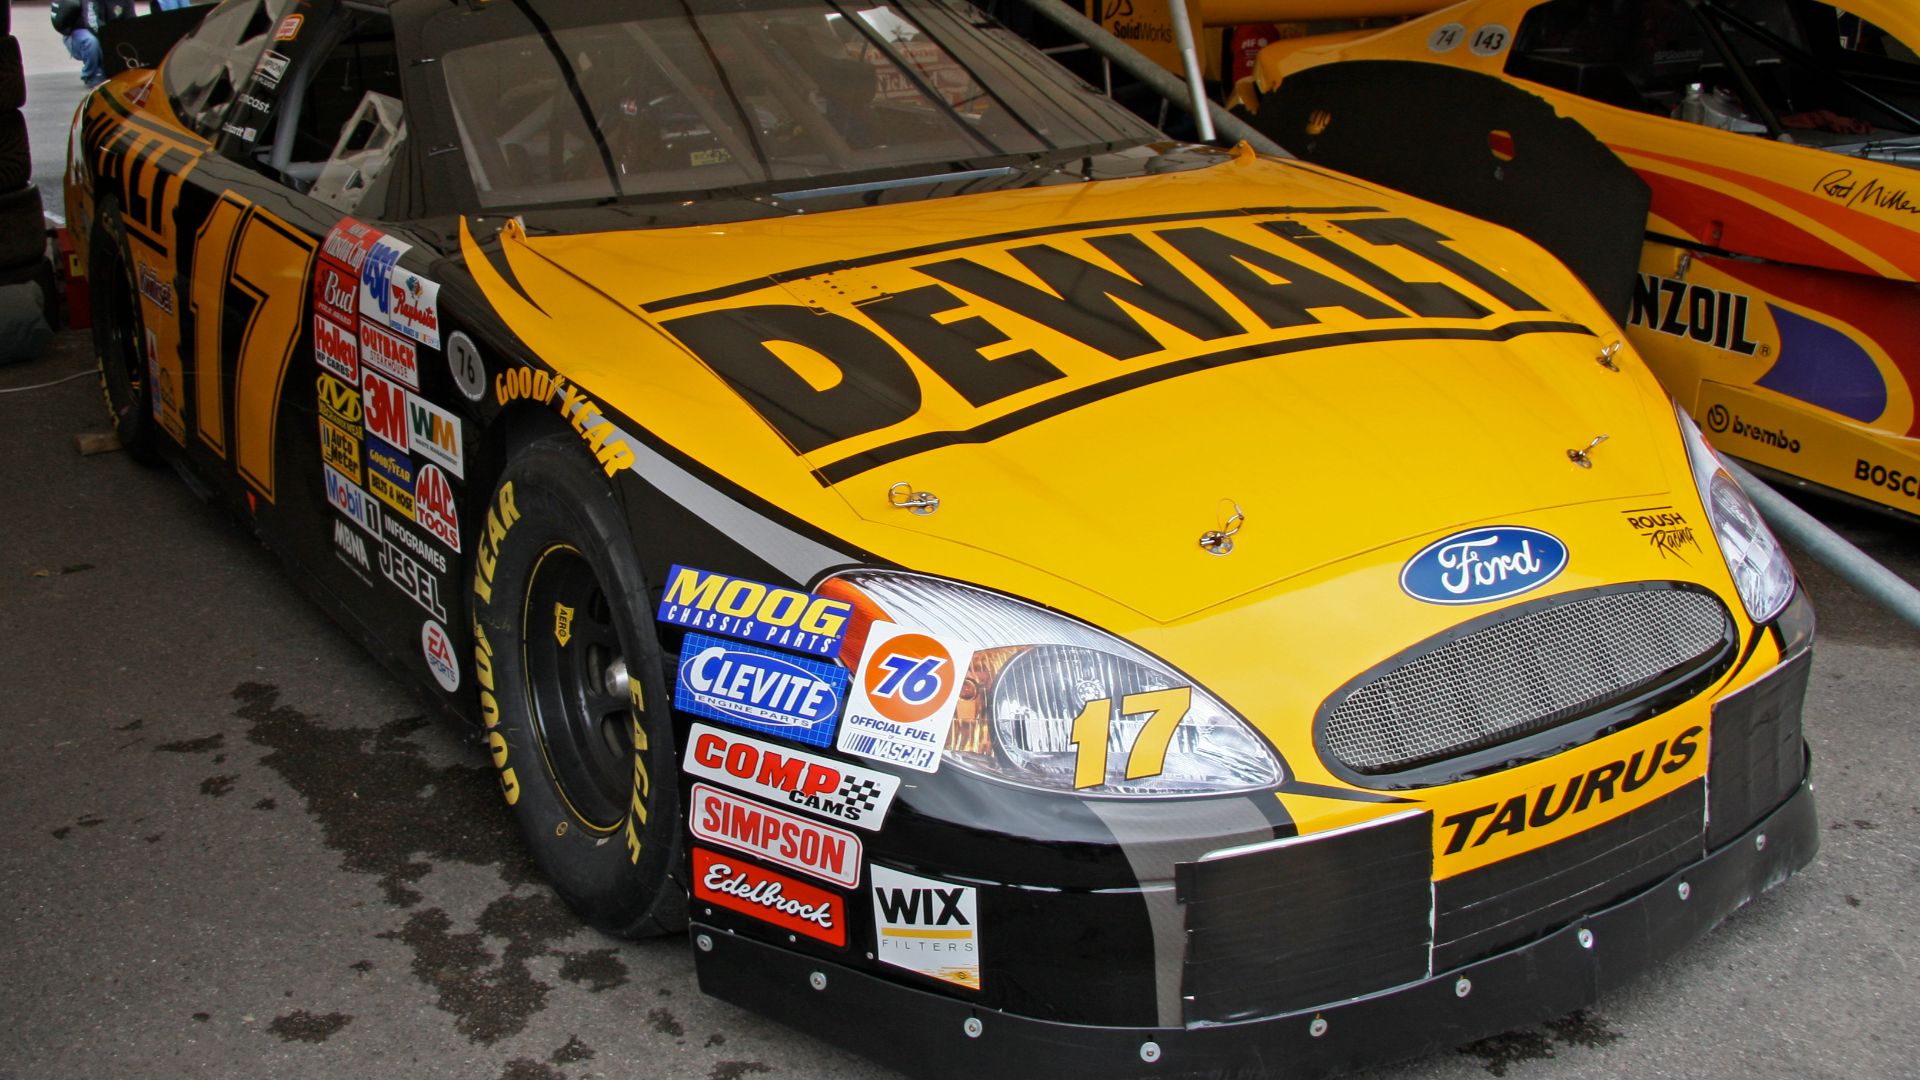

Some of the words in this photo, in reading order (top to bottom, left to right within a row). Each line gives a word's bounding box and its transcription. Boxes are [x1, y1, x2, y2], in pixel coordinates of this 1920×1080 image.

[1113, 21, 1173, 43] SolidWorks
[1436, 30, 1457, 46] 74
[1473, 31, 1505, 50] 143
[1813, 169, 1857, 199] Rod
[324, 271, 357, 315] Bud
[1628, 272, 1760, 357] NZOIL
[189, 189, 320, 505] 17
[316, 319, 358, 381] Holley
[361, 325, 416, 372] OUTBACK
[659, 217, 1551, 457] DEWALT
[326, 357, 351, 379] CARBS
[370, 351, 408, 379] STEAKHOUSE
[457, 346, 476, 385] 76
[364, 373, 409, 450] 3M
[410, 402, 458, 457] WM
[1732, 415, 1801, 453] brembo
[370, 449, 412, 483] GOODYEAR
[326, 469, 364, 523] Mobil
[367, 502, 377, 530] 1
[416, 466, 457, 529] MAC
[334, 519, 371, 571] MBNA
[384, 514, 447, 574] INFOGRAMES
[417, 507, 459, 549] TOOLS
[1627, 512, 1687, 531] ROUSH
[1437, 535, 1544, 594] Ford
[1649, 525, 1704, 568] Racing
[379, 538, 448, 625] JESEL
[664, 567, 851, 639] MOOG
[559, 608, 568, 638] AERO
[667, 605, 754, 636] CHASSIS
[766, 626, 836, 653] PARTS
[427, 626, 454, 670] EA
[428, 652, 456, 684] SPORTS
[690, 647, 832, 717] CLEVITE
[871, 652, 948, 706] 76
[697, 695, 753, 715] ENGINE
[759, 709, 810, 728] PARTS
[850, 714, 902, 735] OFFICIAL
[904, 727, 937, 743] FUEL
[870, 737, 935, 768] NASCAR
[1070, 685, 1192, 791] 17
[626, 674, 651, 866] EAGLE
[694, 732, 843, 798] COMP
[788, 789, 862, 822] CAMS
[1440, 725, 1704, 856] TAURUS
[702, 795, 847, 876] SIMPSON
[703, 863, 834, 930] Edelbrock
[874, 886, 971, 926] WIX
[881, 939, 974, 953] FILTERS
